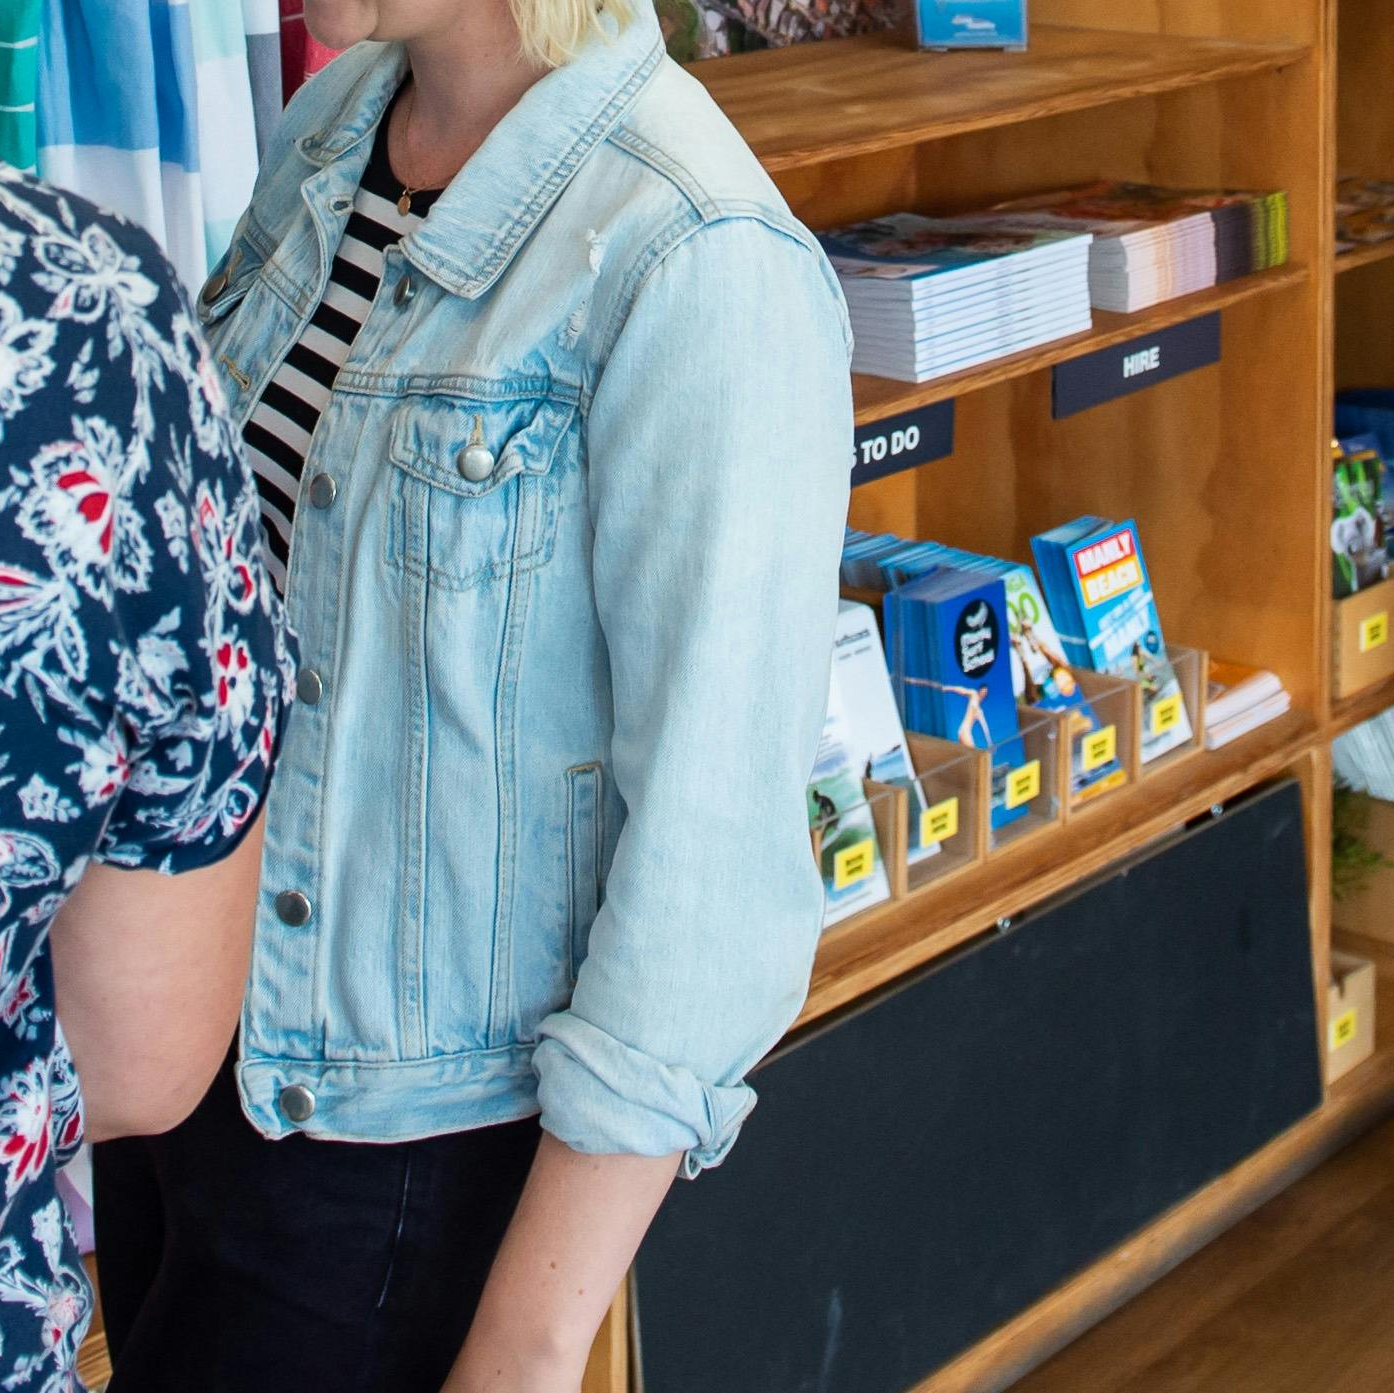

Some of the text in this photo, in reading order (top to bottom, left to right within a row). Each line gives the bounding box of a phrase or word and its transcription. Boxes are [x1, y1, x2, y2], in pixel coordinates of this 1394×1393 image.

[1122, 345, 1161, 379] HIRE
[860, 436, 887, 465] TO
[891, 425, 920, 456] DO
[1078, 532, 1131, 576] MANLY
[1085, 560, 1140, 603] BEACH
